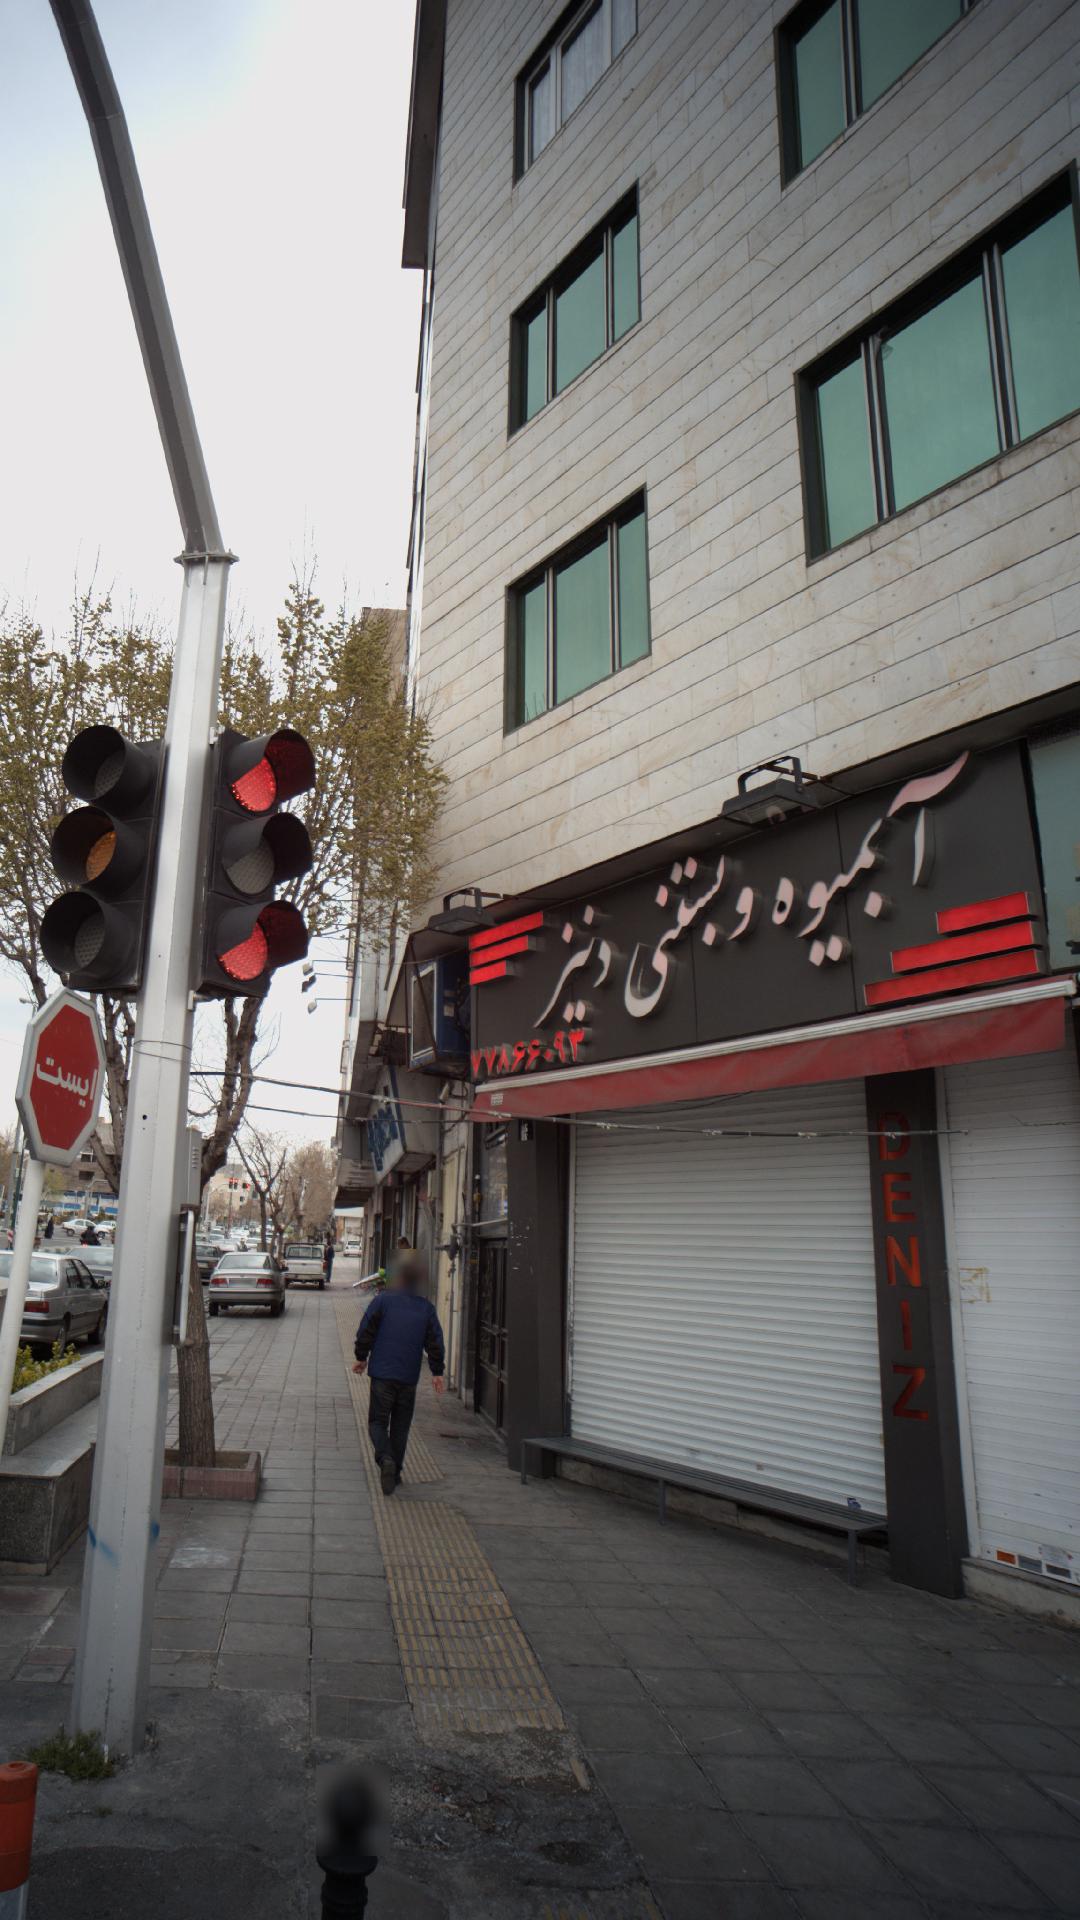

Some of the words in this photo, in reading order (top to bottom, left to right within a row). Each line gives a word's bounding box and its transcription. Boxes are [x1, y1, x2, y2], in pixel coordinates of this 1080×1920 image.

[729, 886, 755, 941] و
[771, 751, 969, 966] آبمیوه
[534, 905, 612, 1028] دنیز
[624, 855, 727, 1018] بستنی
[36, 1057, 98, 1107] ایست
[471, 1027, 586, 1078] ۷۷۸۶۶۰۹۳
[880, 1113, 929, 1420] DENIZ
